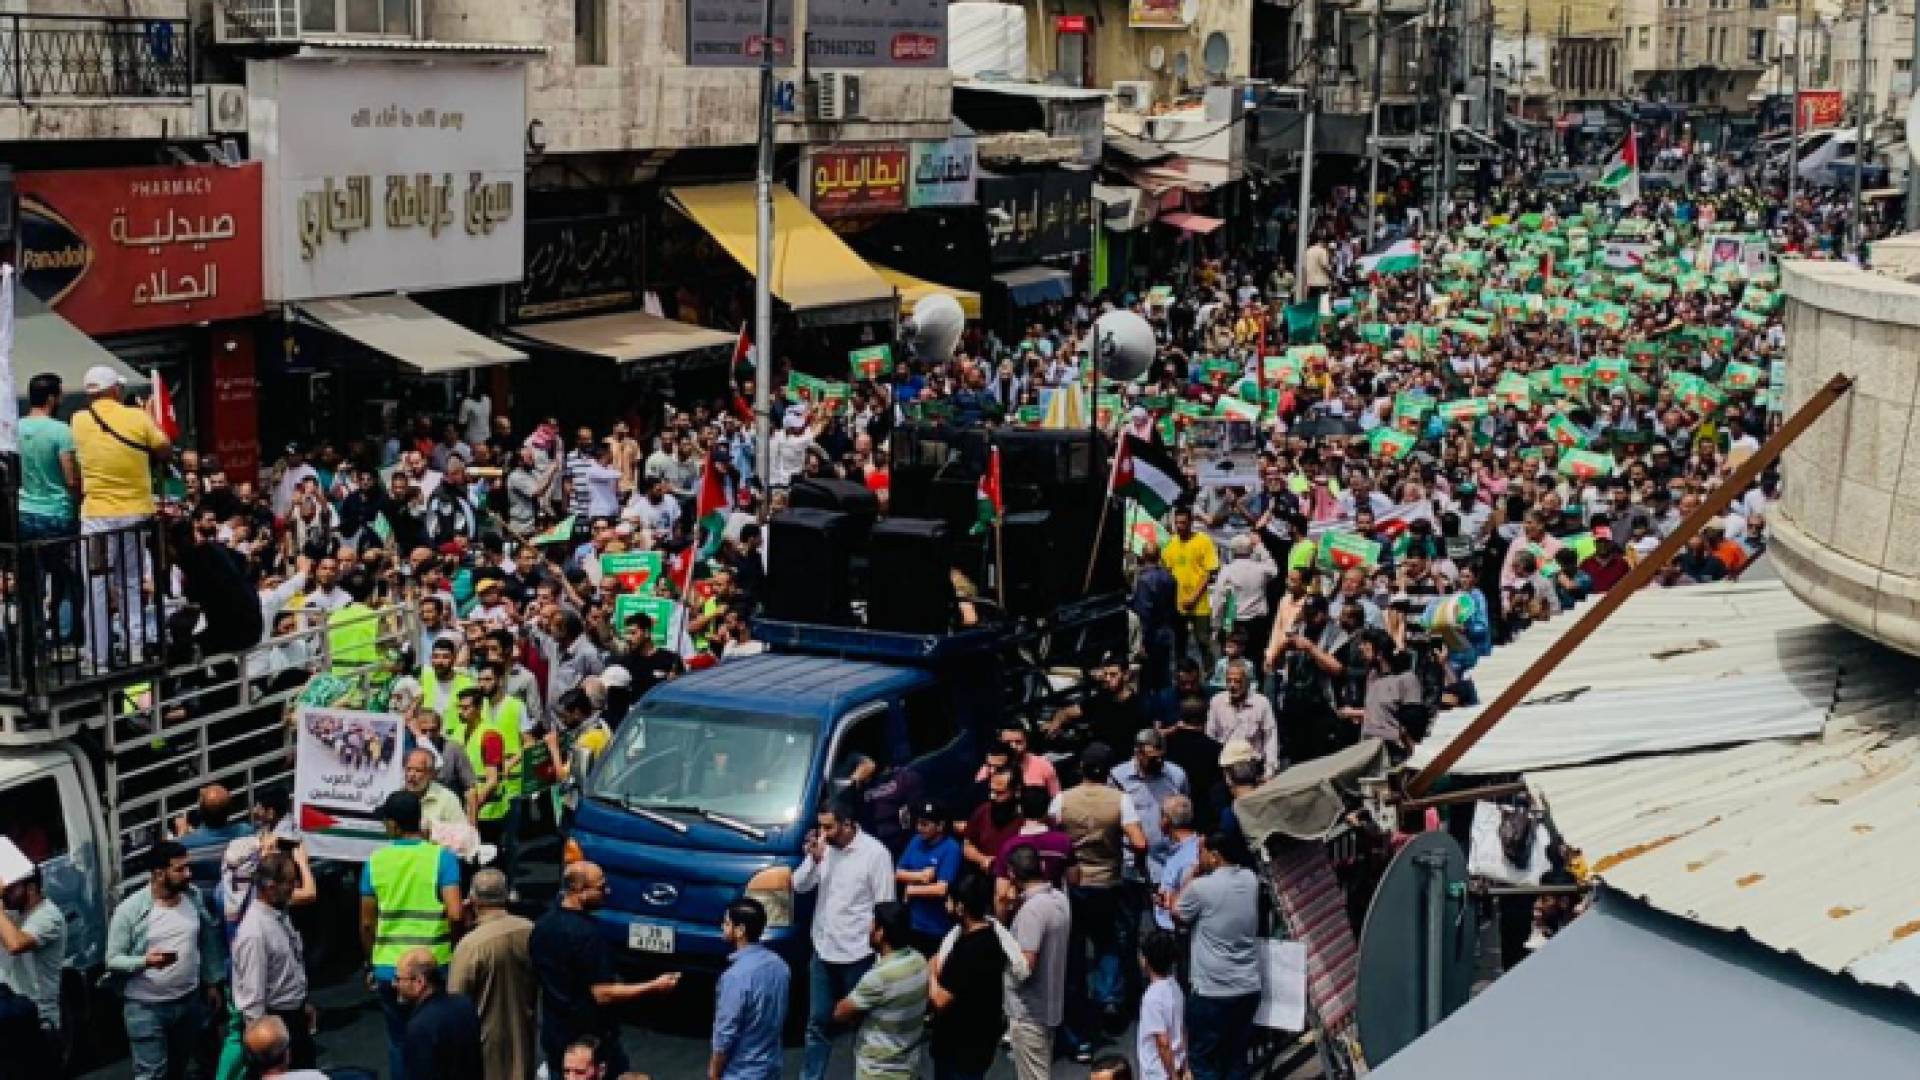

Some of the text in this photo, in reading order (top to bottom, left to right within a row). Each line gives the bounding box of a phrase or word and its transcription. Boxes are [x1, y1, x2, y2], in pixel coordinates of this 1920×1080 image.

[130, 177, 213, 198] PHARMACY
[110, 207, 236, 255] صيدلية
[298, 170, 514, 263] سوق غرناطة التجاري
[23, 243, 86, 271] Panadol
[132, 262, 218, 312] الجلاء
